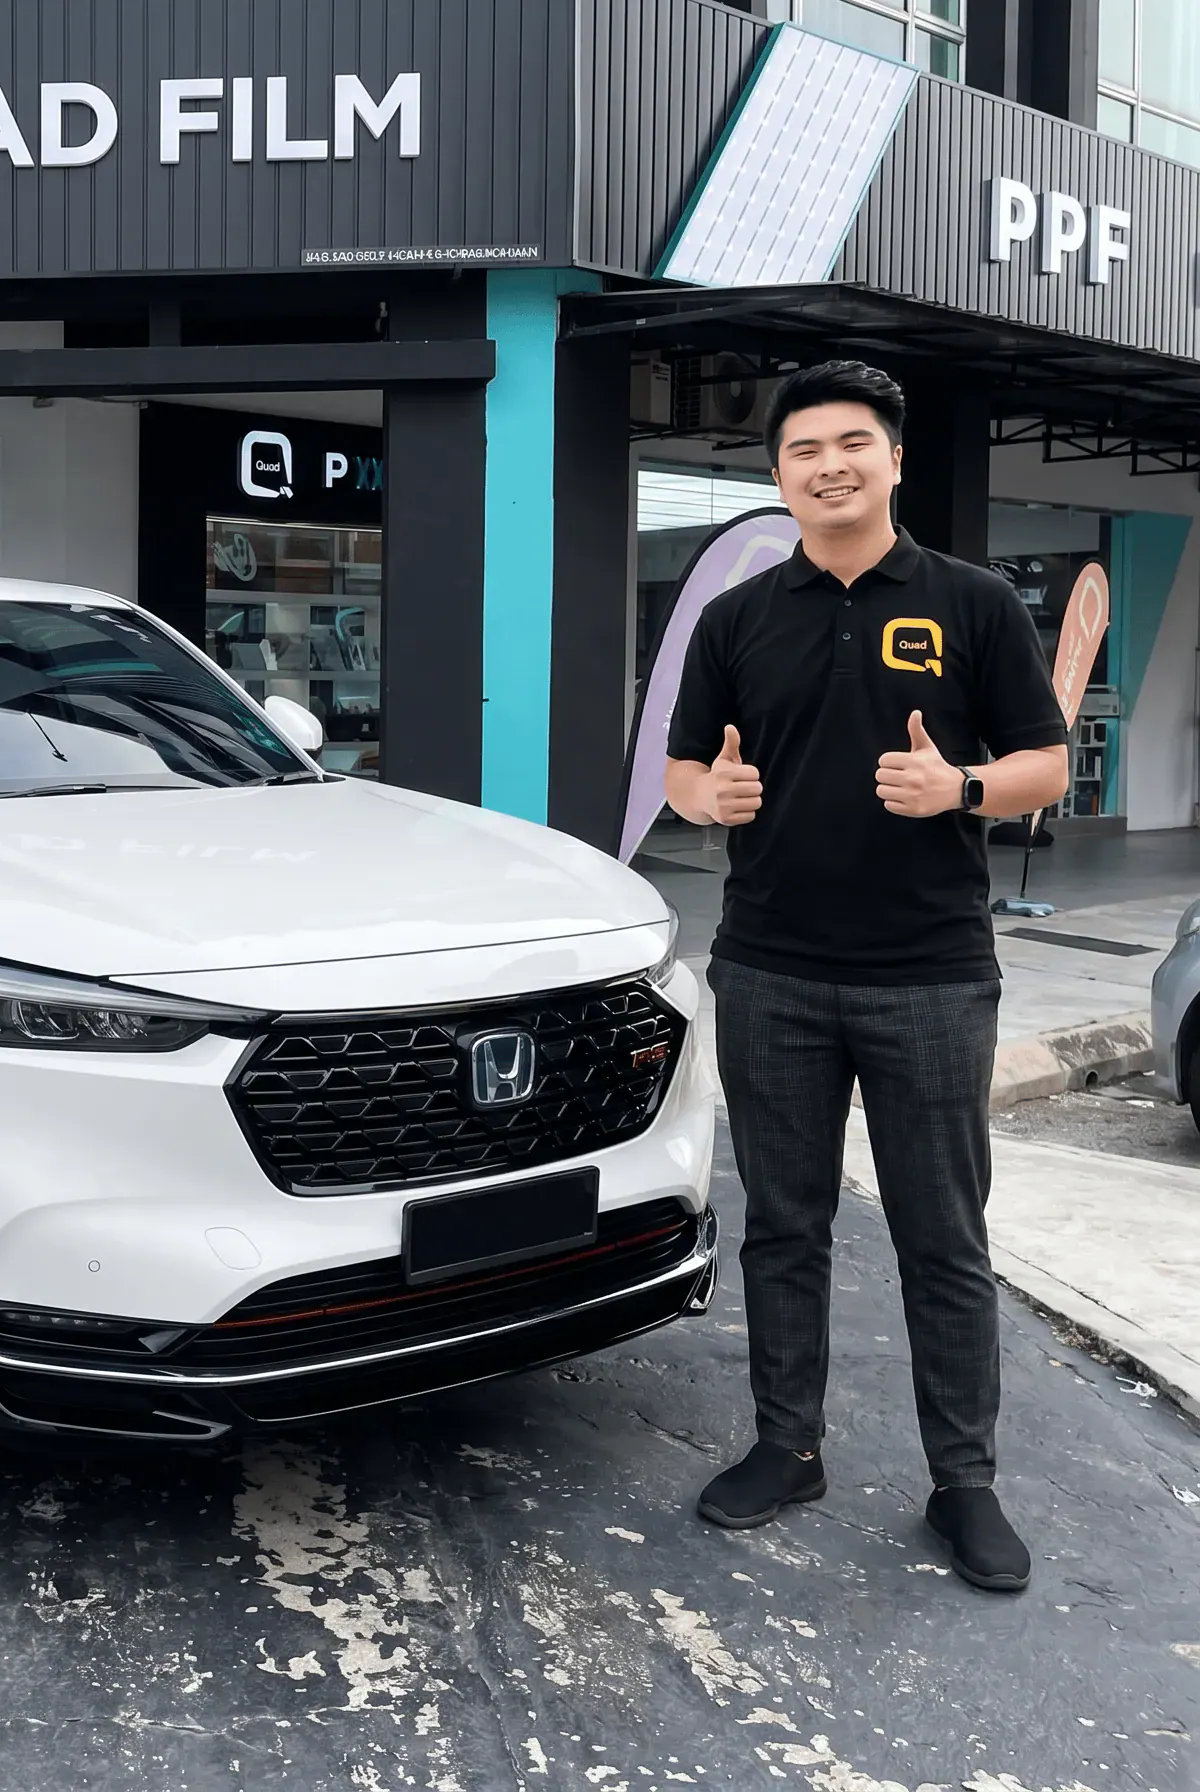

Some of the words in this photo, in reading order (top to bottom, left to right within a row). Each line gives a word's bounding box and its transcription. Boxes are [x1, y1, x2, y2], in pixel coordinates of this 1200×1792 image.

[159, 72, 421, 166] FILM
[989, 176, 1131, 286] PPF
[255, 459, 281, 473] Quad
[899, 639, 928, 650] Quad
